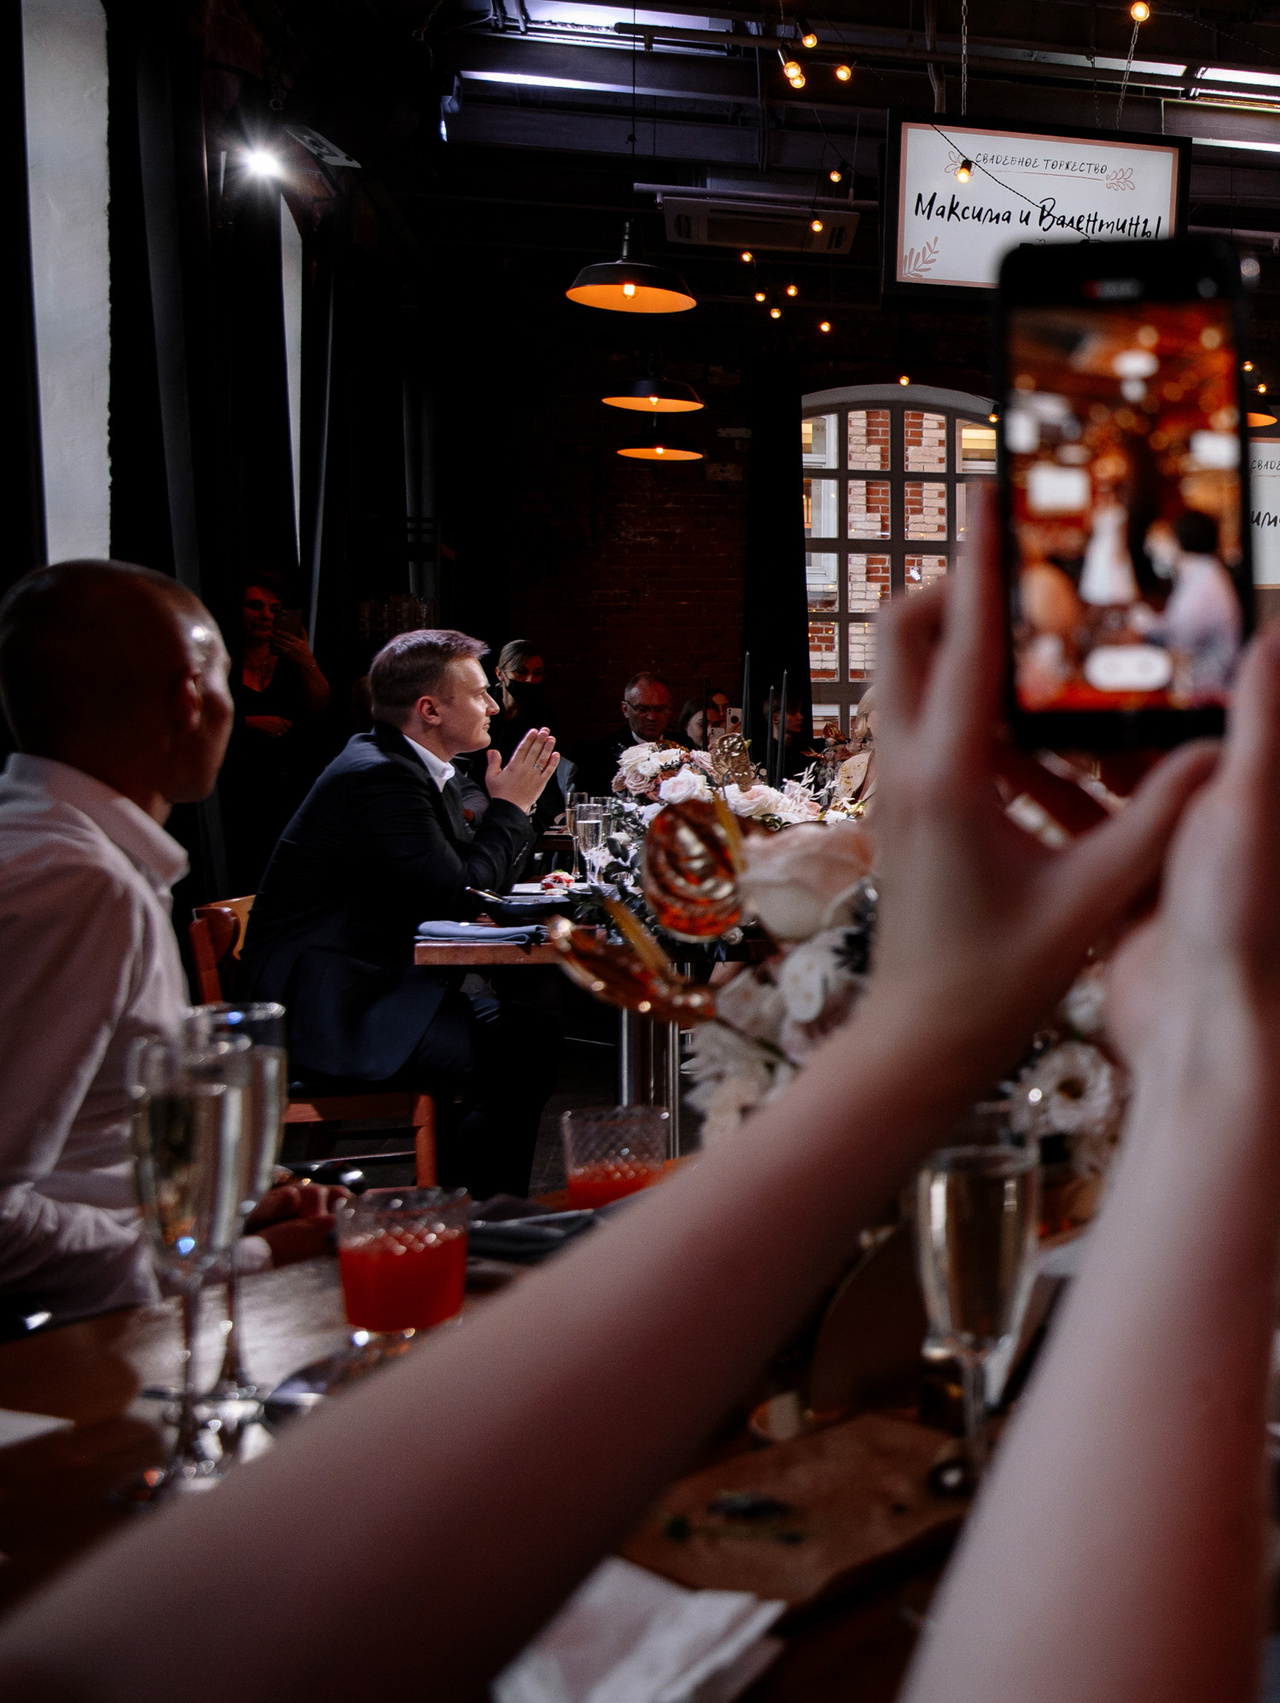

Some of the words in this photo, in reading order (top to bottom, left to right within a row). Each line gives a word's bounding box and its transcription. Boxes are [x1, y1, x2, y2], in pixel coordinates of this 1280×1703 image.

[1043, 158, 1108, 175] ТОРЖЕСТВО
[914, 192, 1012, 226] Максима
[1019, 210, 1032, 226] и
[1037, 197, 1162, 239] Валентины
